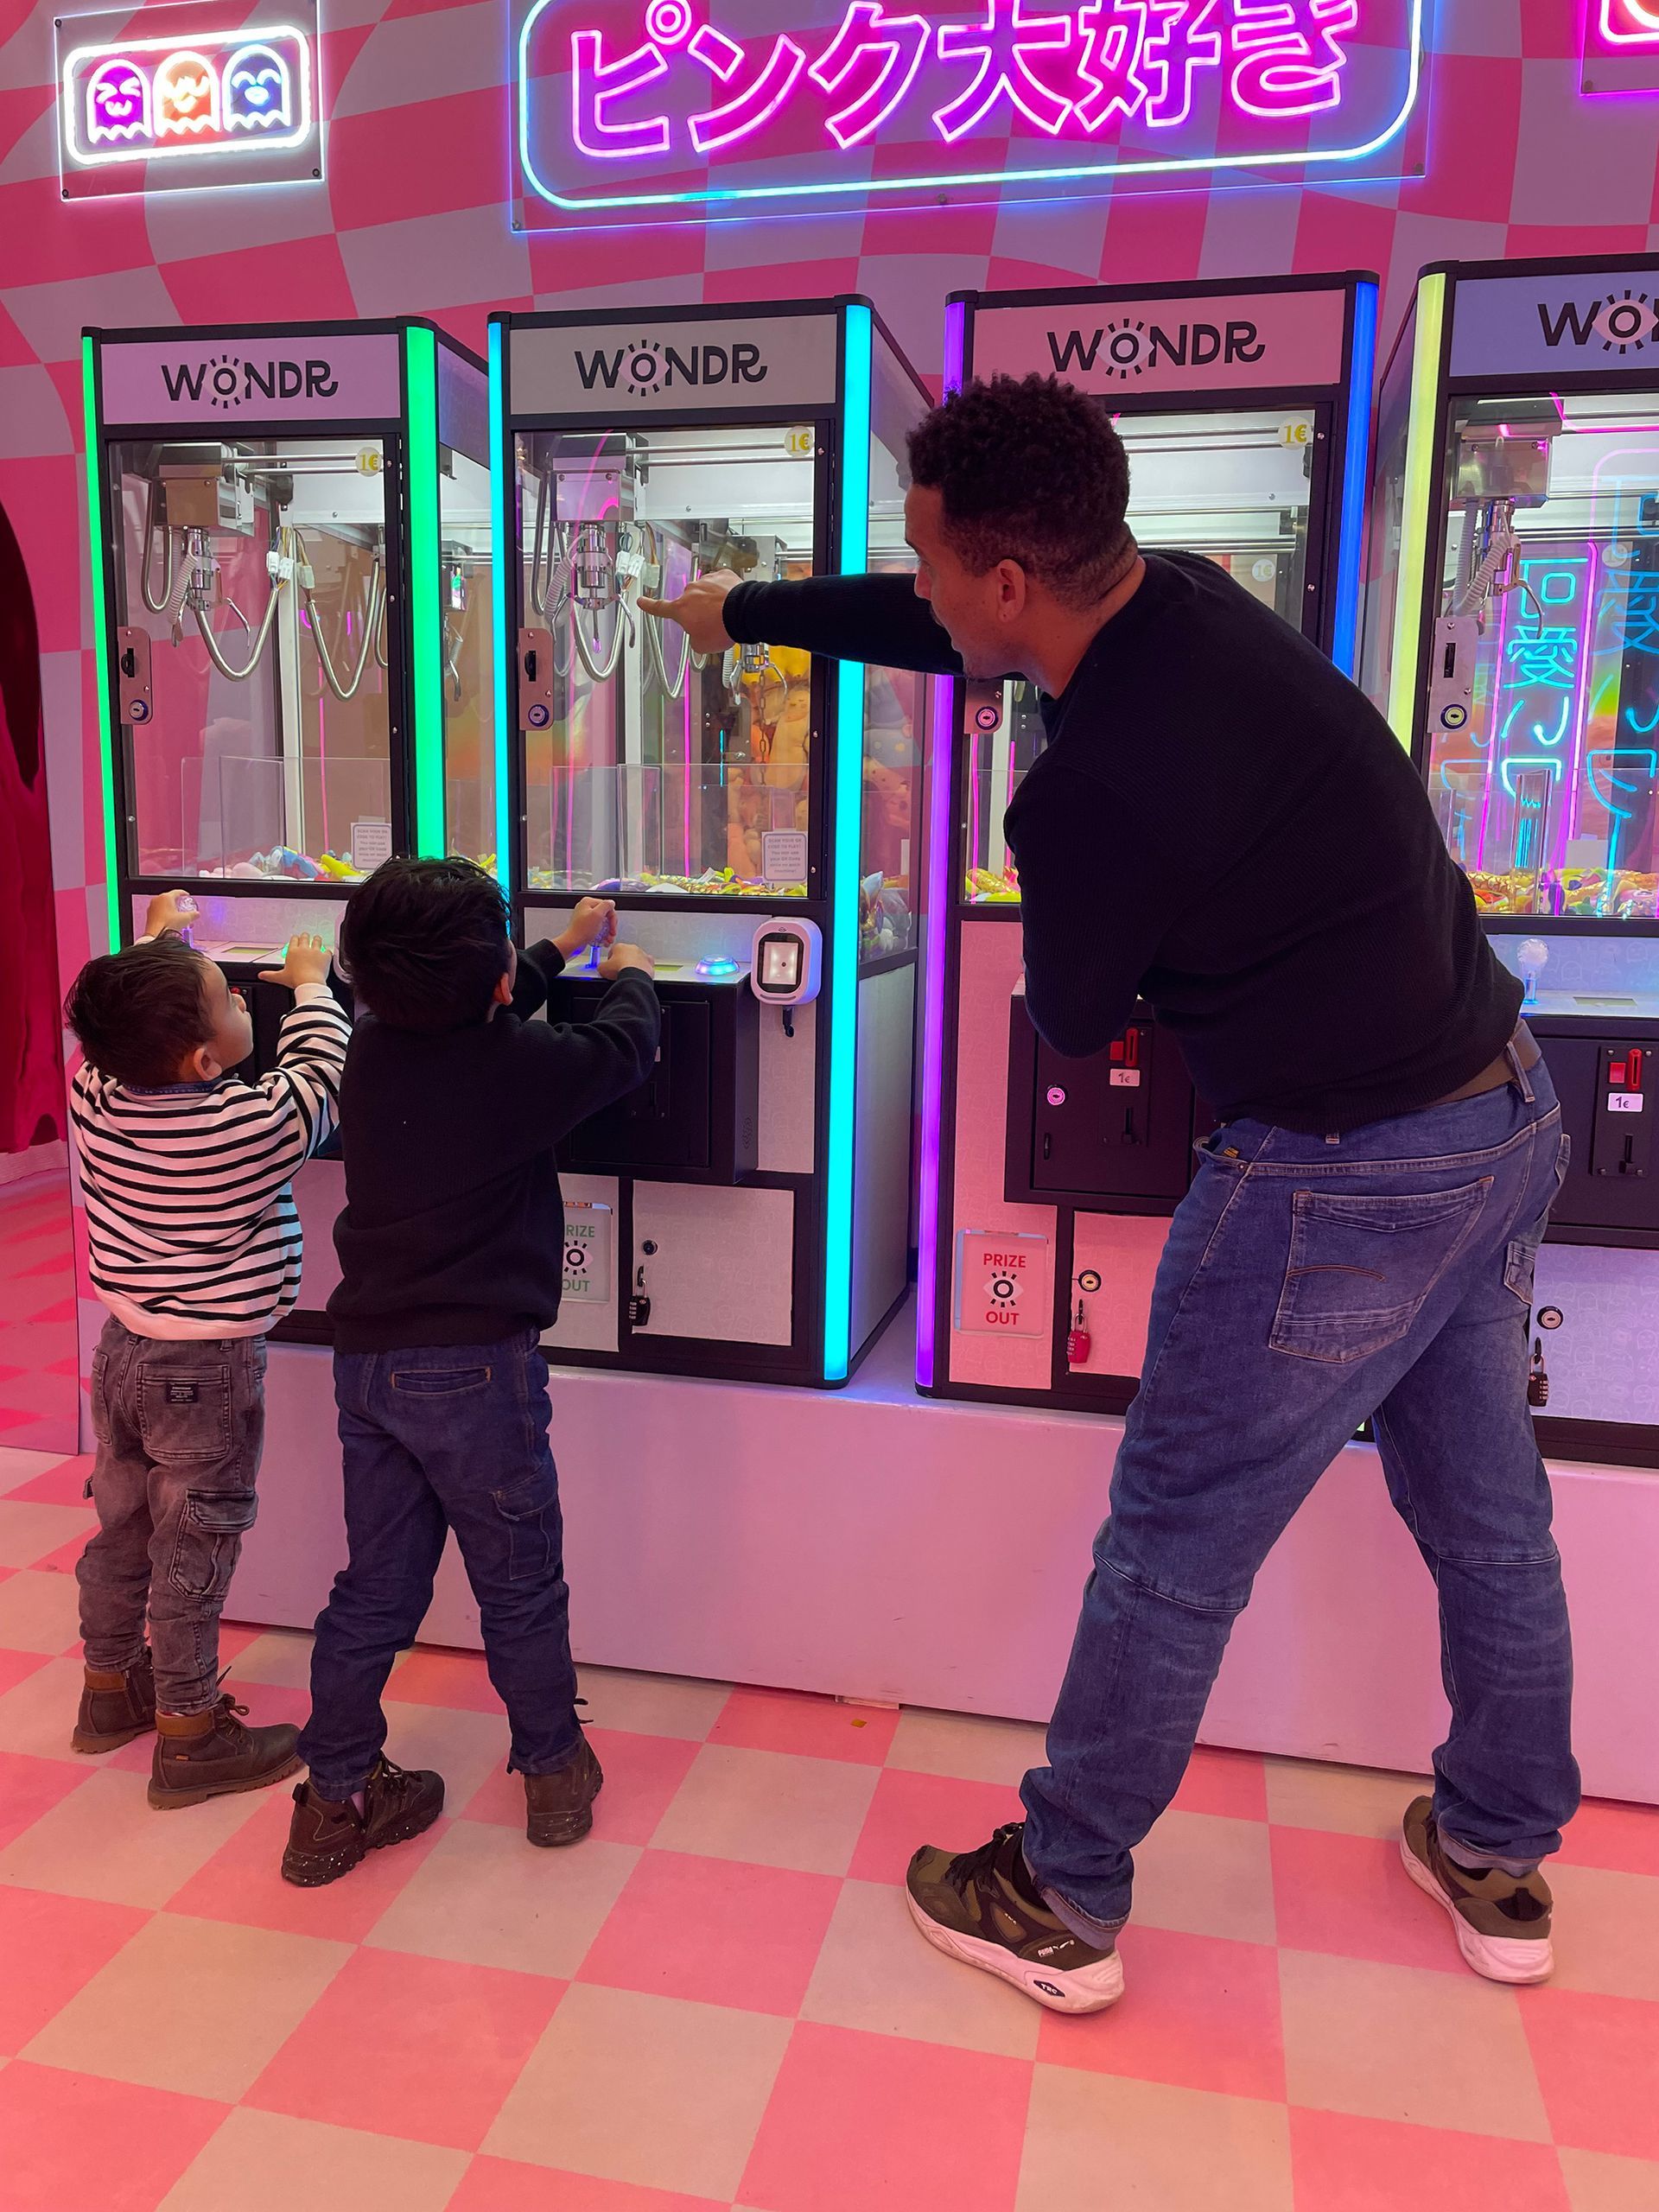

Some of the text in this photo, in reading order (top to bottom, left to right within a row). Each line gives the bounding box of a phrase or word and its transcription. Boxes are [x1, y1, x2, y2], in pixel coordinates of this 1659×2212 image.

[1046, 318, 1266, 378] WONDR
[575, 339, 767, 397] WONDR
[161, 354, 339, 409] WONDR
[788, 432, 810, 452] 1€
[1283, 423, 1307, 444] 1€
[359, 455, 379, 472] 1€
[1118, 1072, 1130, 1084] 1€
[1615, 1096, 1630, 1109] 1€
[565, 1224, 594, 1237] RIZE
[982, 1253, 1027, 1268] PRIZE
[985, 1311, 1020, 1325] OUT
